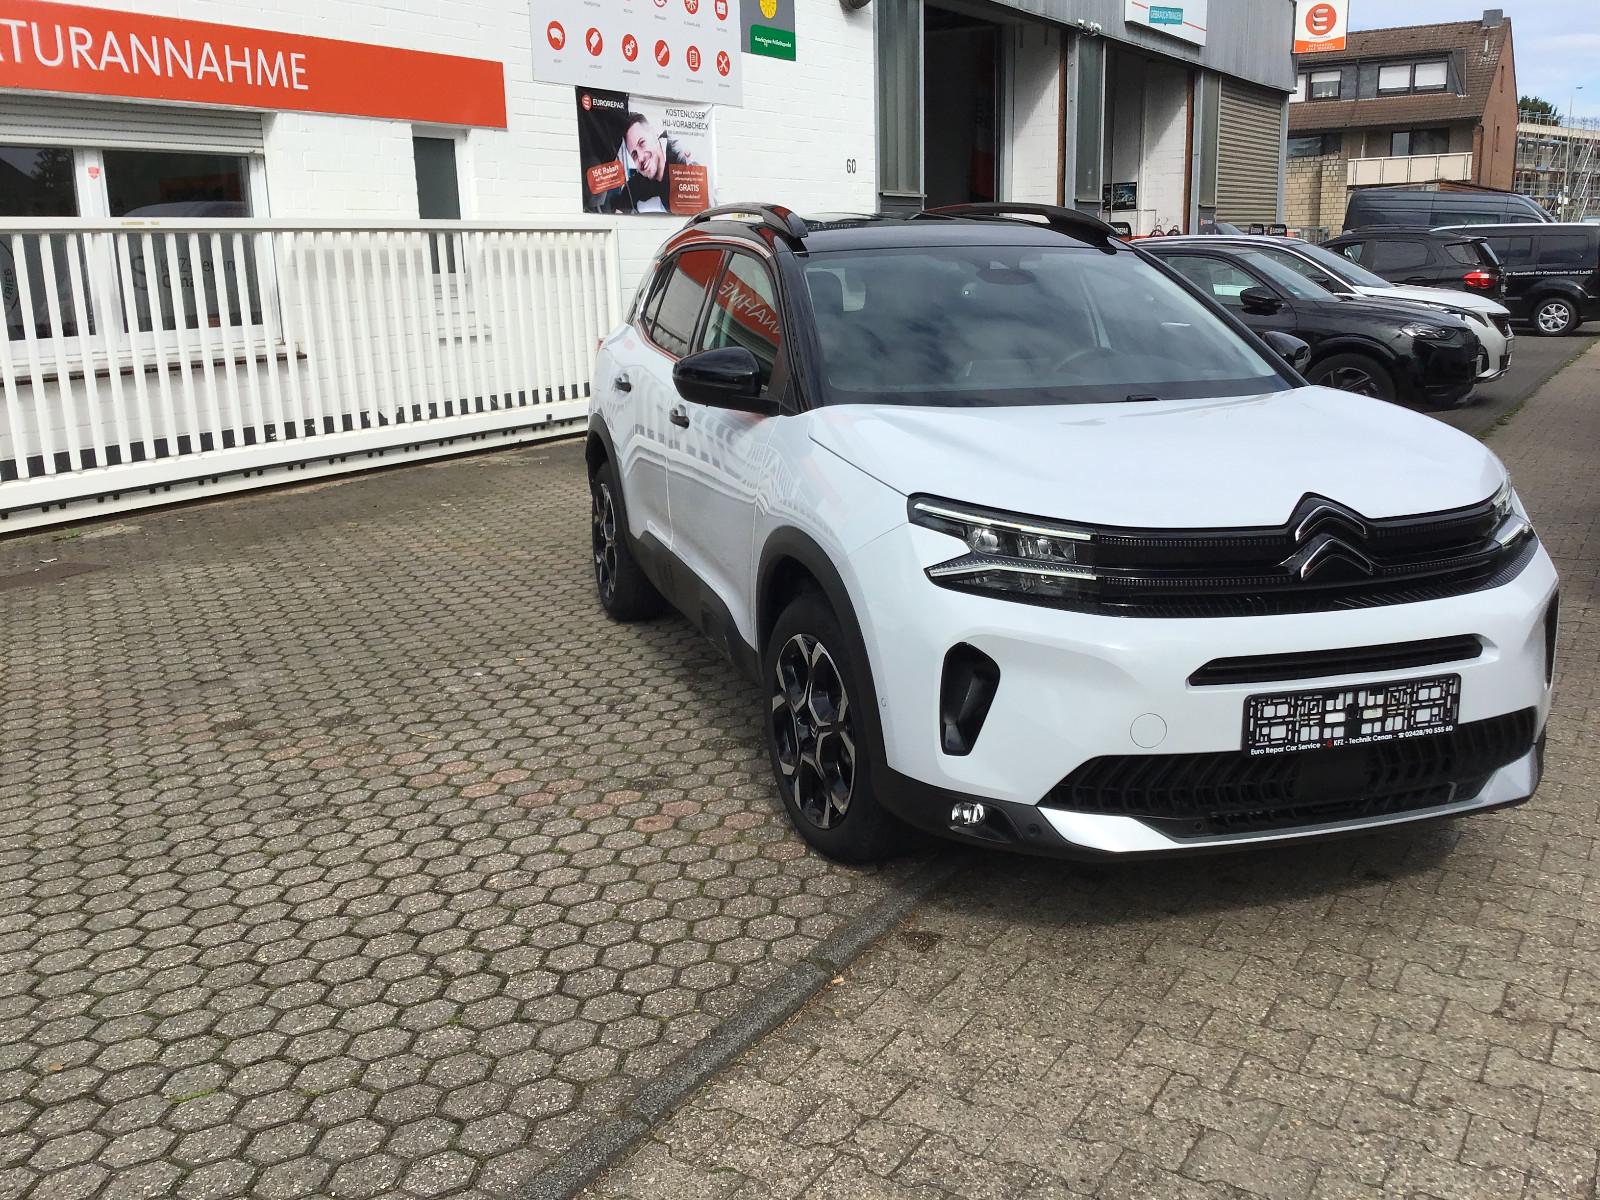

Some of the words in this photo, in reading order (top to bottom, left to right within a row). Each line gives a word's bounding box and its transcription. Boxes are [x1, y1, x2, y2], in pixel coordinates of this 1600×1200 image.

[0, 18, 309, 90] TURANNAHME
[592, 98, 625, 110] EUROREPAR
[665, 108, 706, 120] KOSTENLOSER
[662, 119, 709, 130] HU-VORABCHECK
[846, 158, 857, 174] 60
[678, 183, 700, 192] GRATIS
[1250, 748, 1264, 756] Euro
[1266, 746, 1284, 754] Repar
[1298, 742, 1321, 750] Service
[1348, 736, 1372, 744] Technik
